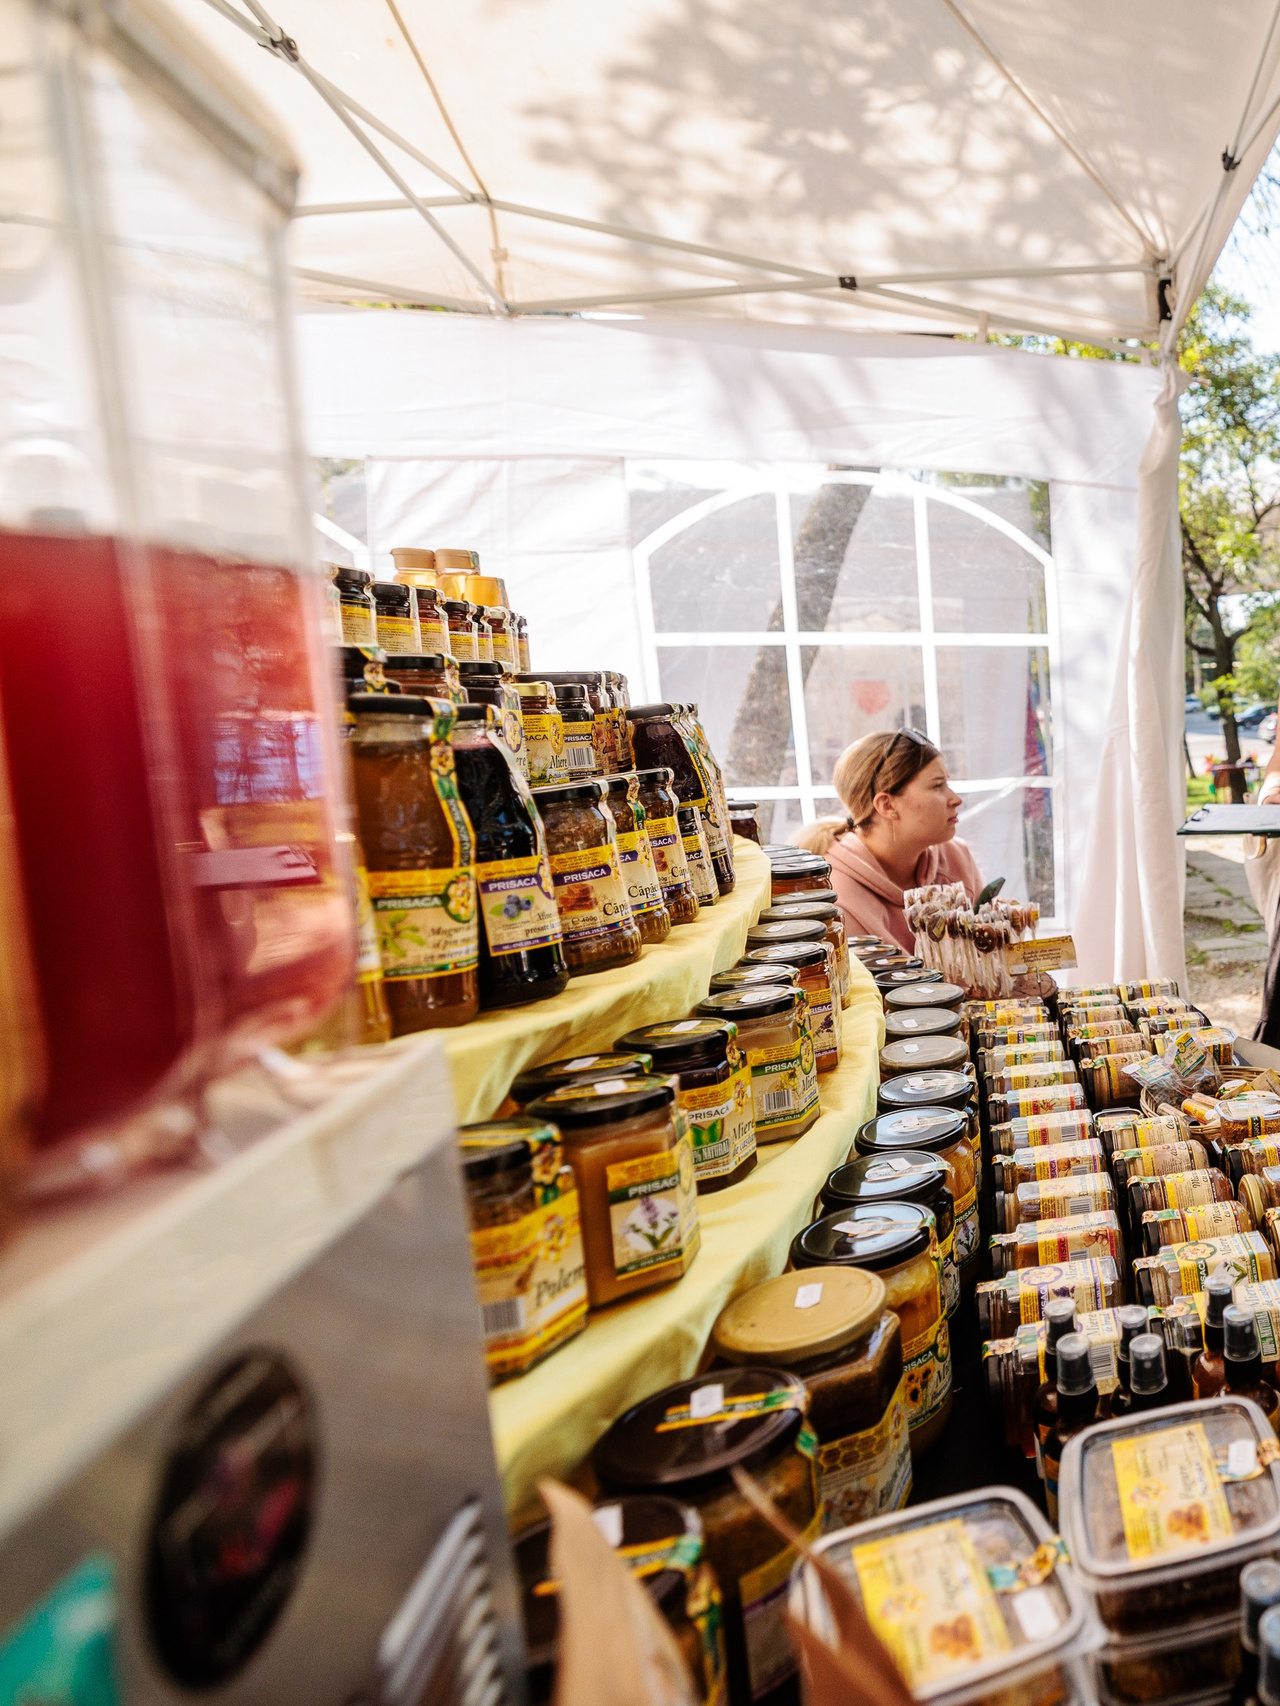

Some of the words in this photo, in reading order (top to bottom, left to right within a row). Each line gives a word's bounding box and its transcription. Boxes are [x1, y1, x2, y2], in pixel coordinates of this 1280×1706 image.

[523, 734, 549, 742] SACA
[650, 837, 674, 848] ISACA
[488, 877, 538, 892] PRISACA
[563, 867, 607, 883] PRISACA
[809, 1003, 832, 1014] RISAC
[701, 1139, 729, 1161] NATURAL
[954, 1204, 976, 1226] PRISACA
[1058, 1238, 1068, 1262] RISAC
[1198, 1260, 1208, 1291] RISAC
[1255, 1311, 1274, 1339] NATURAL
[903, 1350, 933, 1374] RISACA
